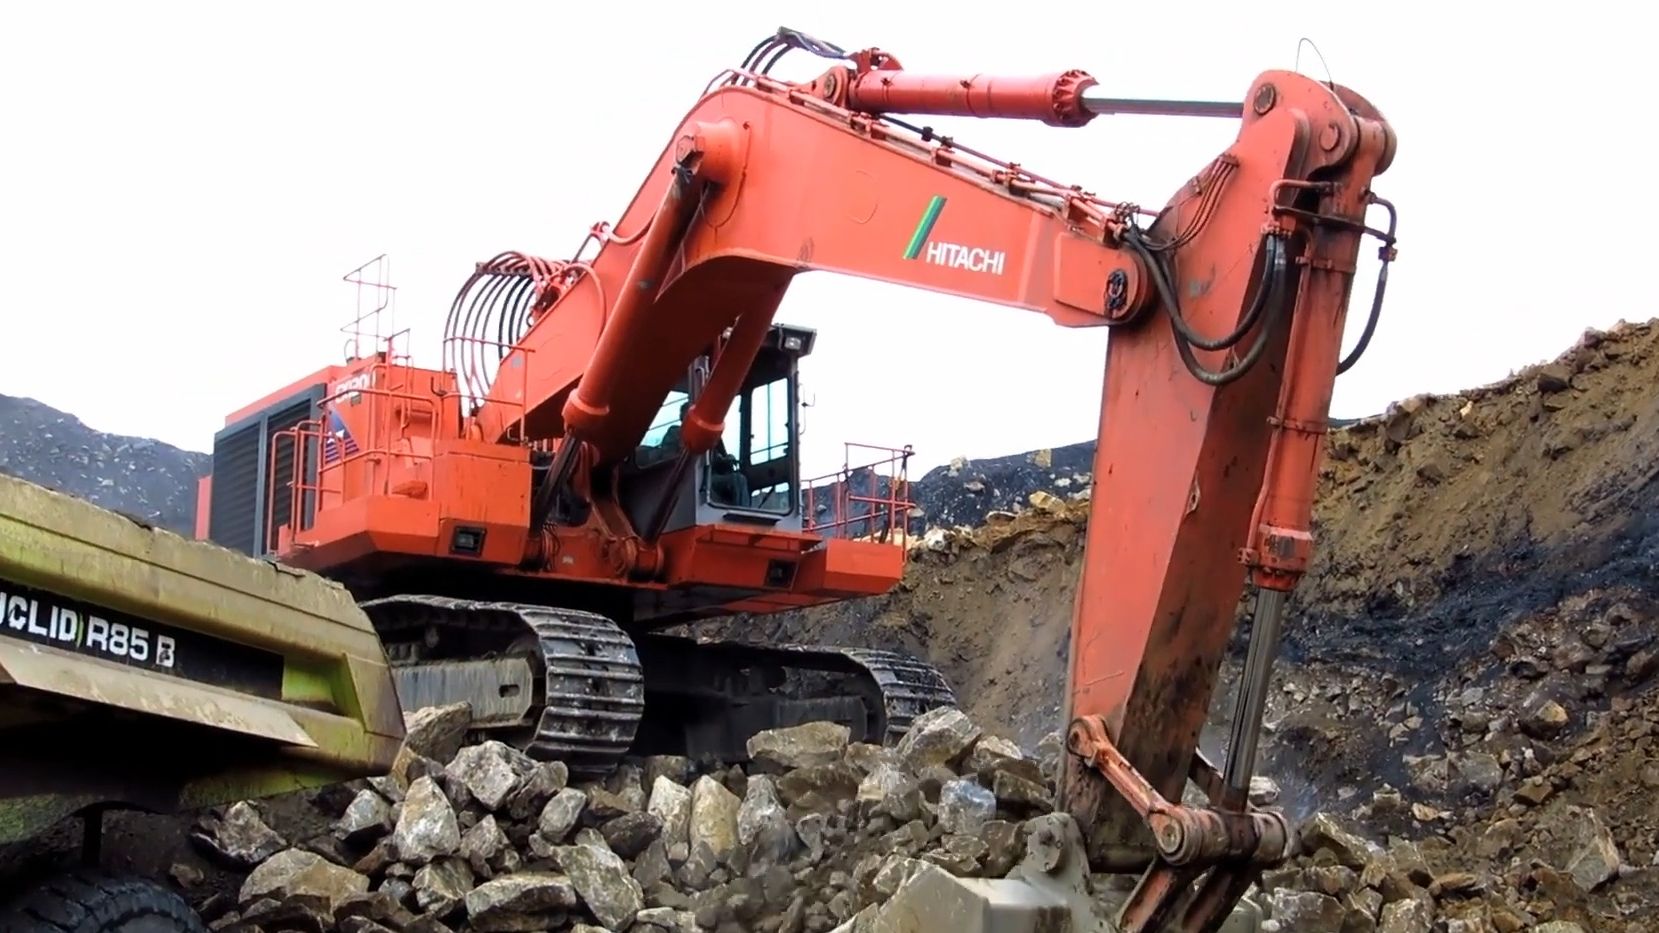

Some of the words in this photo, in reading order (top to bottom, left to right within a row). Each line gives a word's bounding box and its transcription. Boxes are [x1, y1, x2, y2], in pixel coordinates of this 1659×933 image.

[926, 241, 1005, 275] HITACHI
[86, 615, 149, 661] R85
[156, 634, 175, 667] B
